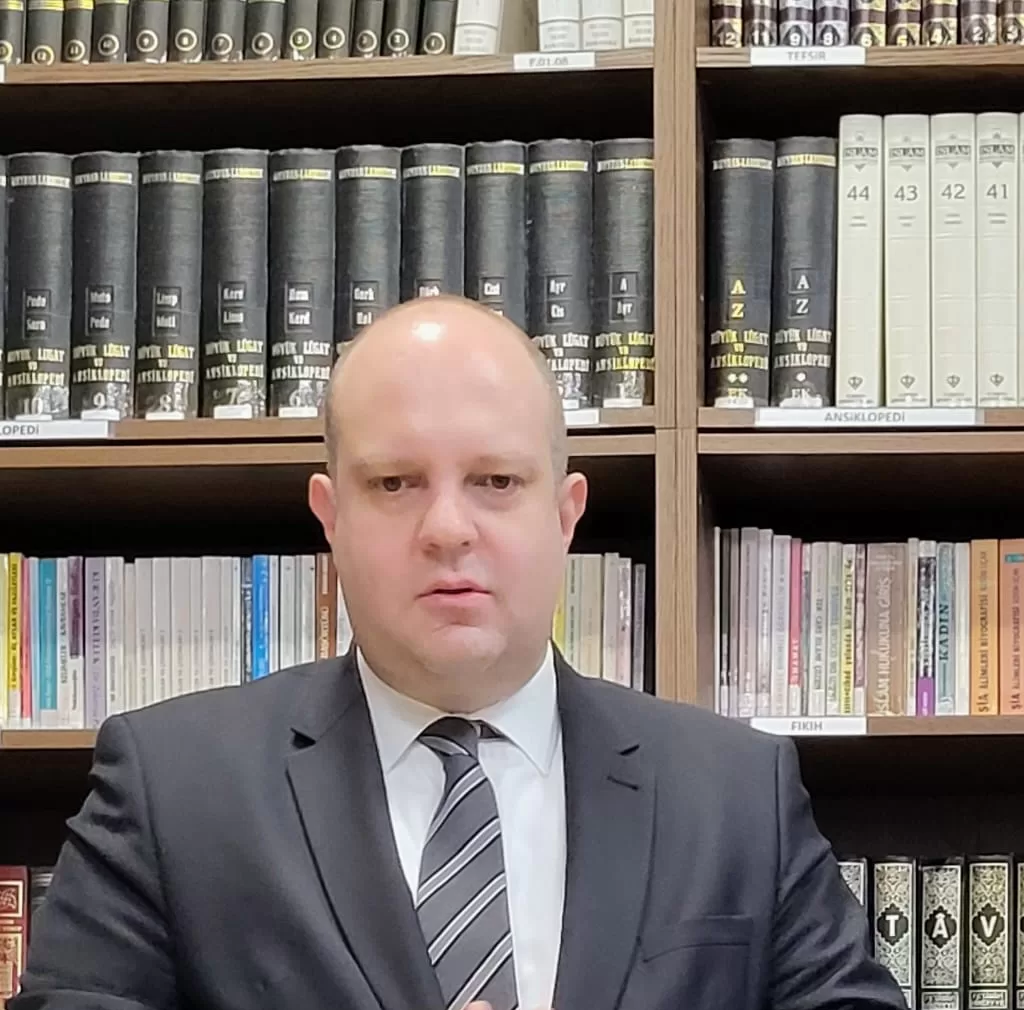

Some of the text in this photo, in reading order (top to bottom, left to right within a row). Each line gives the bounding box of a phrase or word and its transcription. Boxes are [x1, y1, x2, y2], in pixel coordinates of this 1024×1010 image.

[790, 32, 800, 45] 9
[862, 33, 872, 46] 6
[787, 51, 826, 60] TEFSİR
[847, 186, 869, 200] 44
[895, 185, 918, 200] 43
[942, 184, 965, 199] 42
[987, 181, 1010, 199] 41
[731, 279, 746, 294] A
[797, 275, 809, 290] A
[731, 304, 744, 318] Z
[796, 299, 809, 314] Z
[824, 412, 905, 422] ANSİKLOPEDİ
[938, 603, 949, 661] KADIN
[791, 721, 823, 731] FIKIH
[885, 914, 899, 937] T
[981, 915, 998, 938] V
